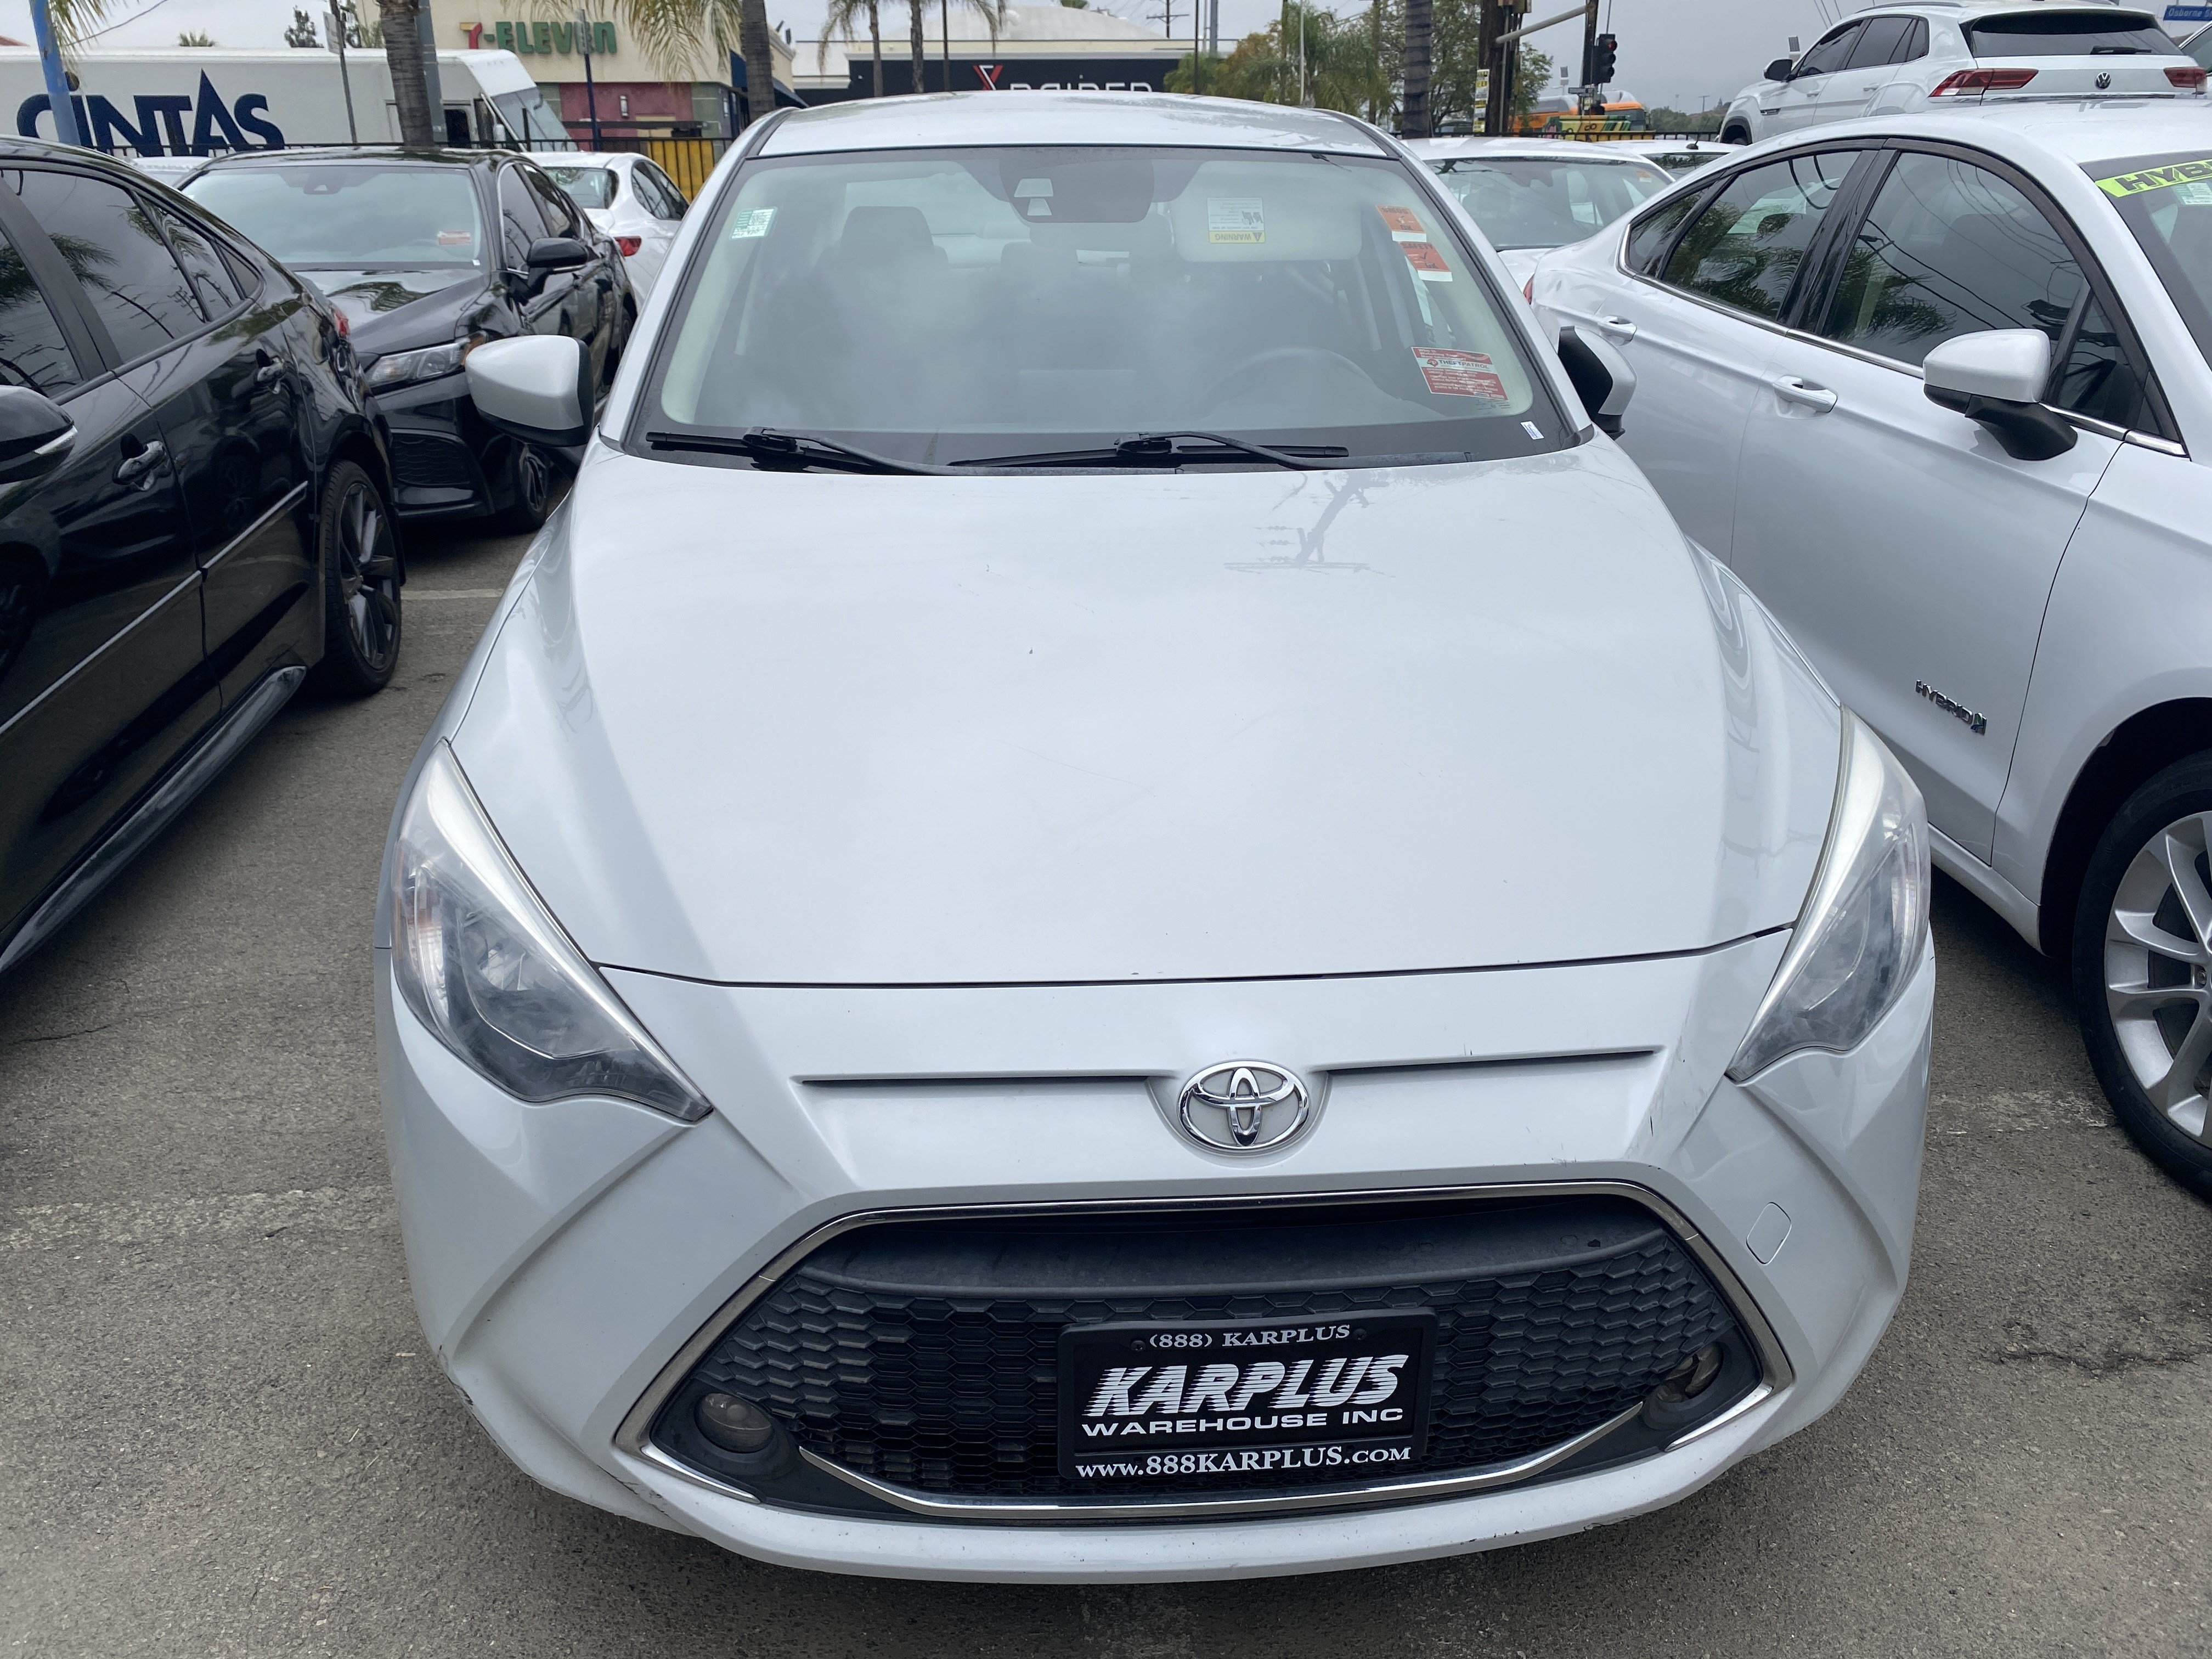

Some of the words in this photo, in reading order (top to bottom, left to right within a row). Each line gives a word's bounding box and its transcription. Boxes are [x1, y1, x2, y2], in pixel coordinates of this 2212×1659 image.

[2114, 161, 2212, 191] HYB
[1438, 360, 1490, 369] THEFTPATROL
[1916, 679, 1973, 725] HYBRID
[1149, 1333, 1212, 1347] (888)
[1222, 1324, 1350, 1346] KARPLUS
[1082, 1354, 1409, 1417] KARPLUS
[1081, 1413, 1328, 1436] WAREHOUSE
[1342, 1408, 1403, 1424] INC
